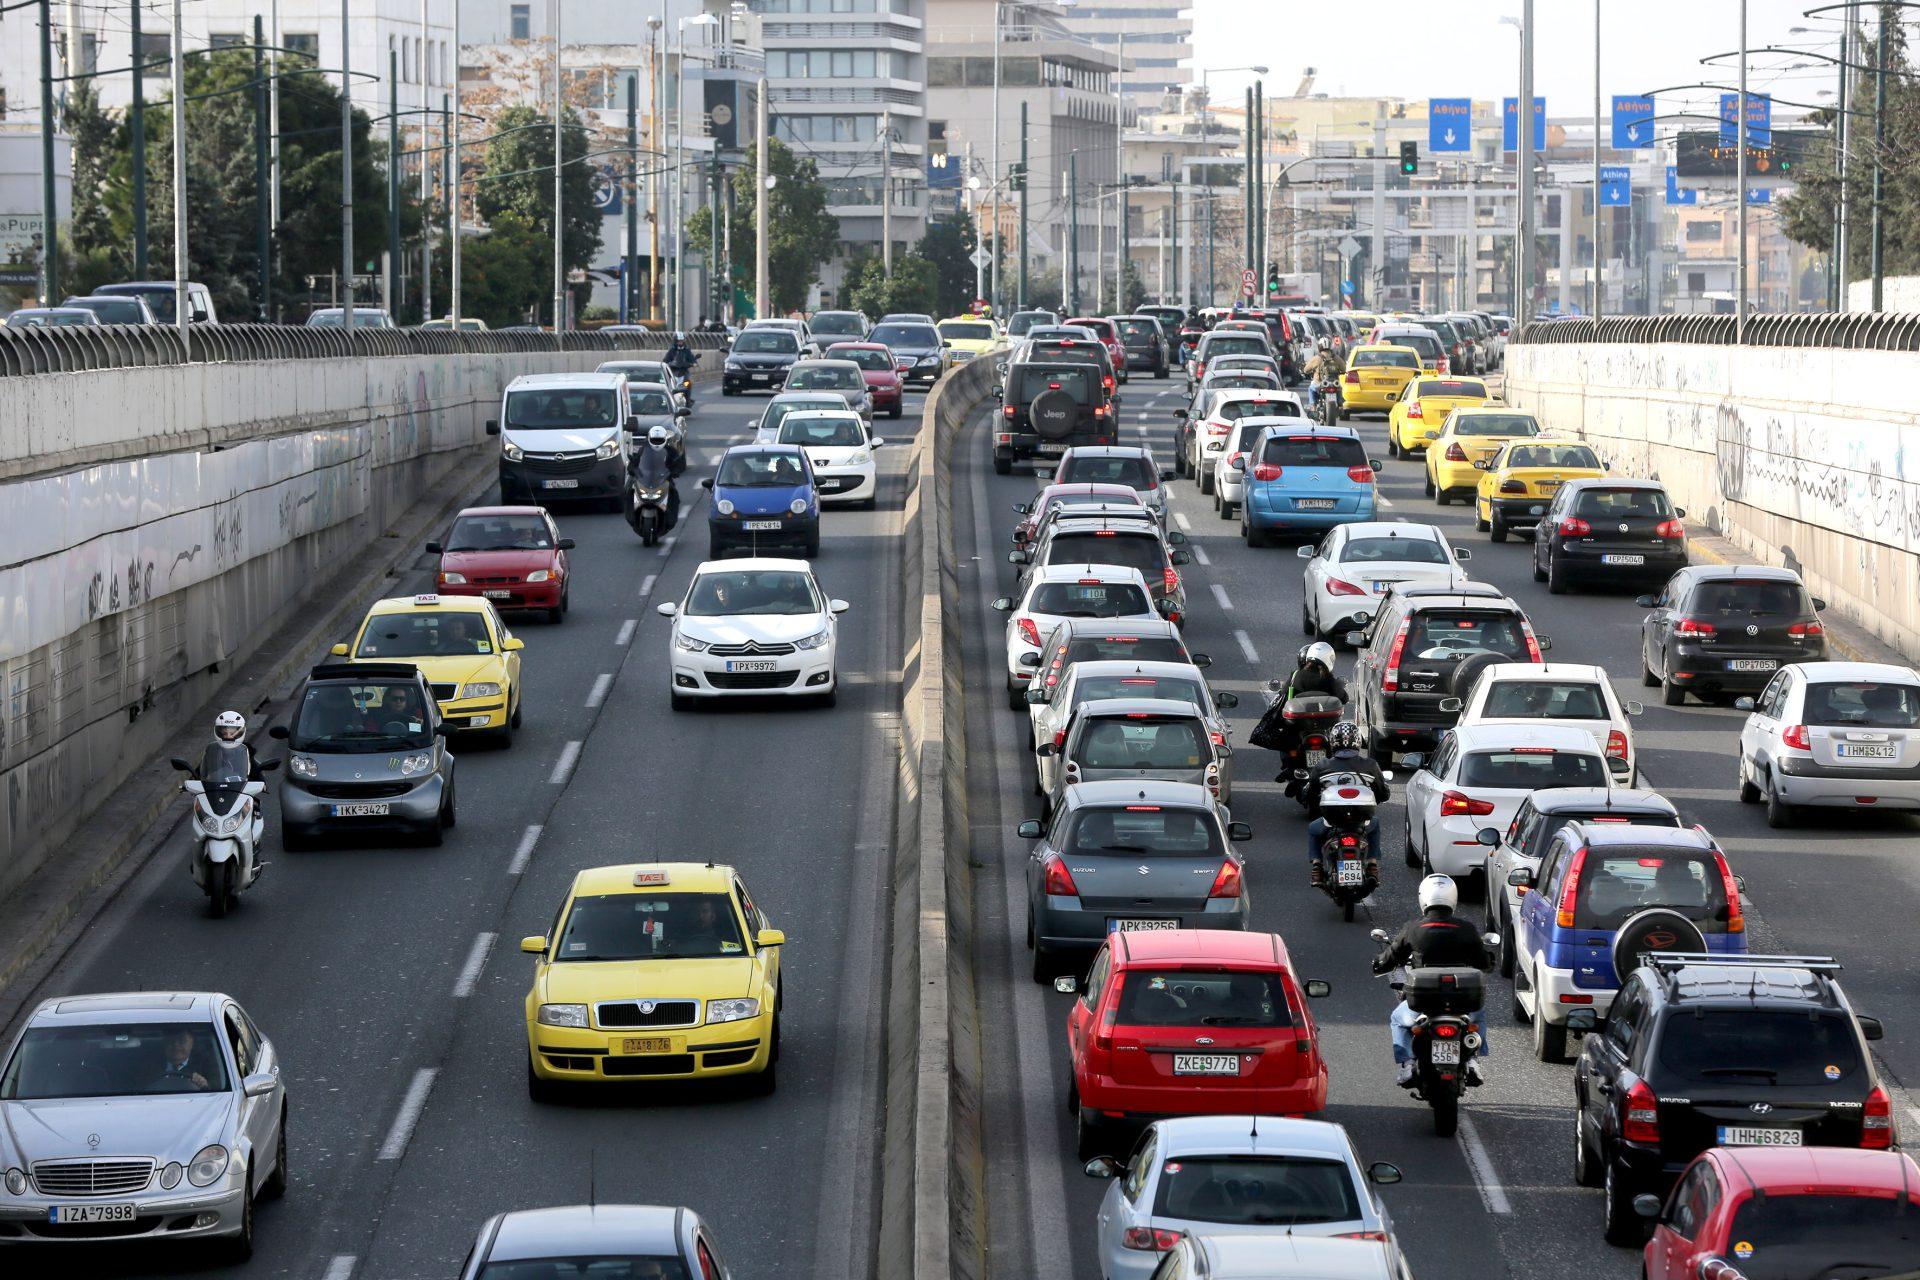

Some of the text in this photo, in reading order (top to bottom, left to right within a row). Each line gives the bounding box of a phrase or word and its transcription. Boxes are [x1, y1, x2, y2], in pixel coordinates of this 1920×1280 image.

[1434, 103, 1467, 115] Αθήνα
[1044, 409, 1066, 420] Jeep
[1344, 873, 1361, 881] 694
[1433, 1052, 1452, 1062] 556
